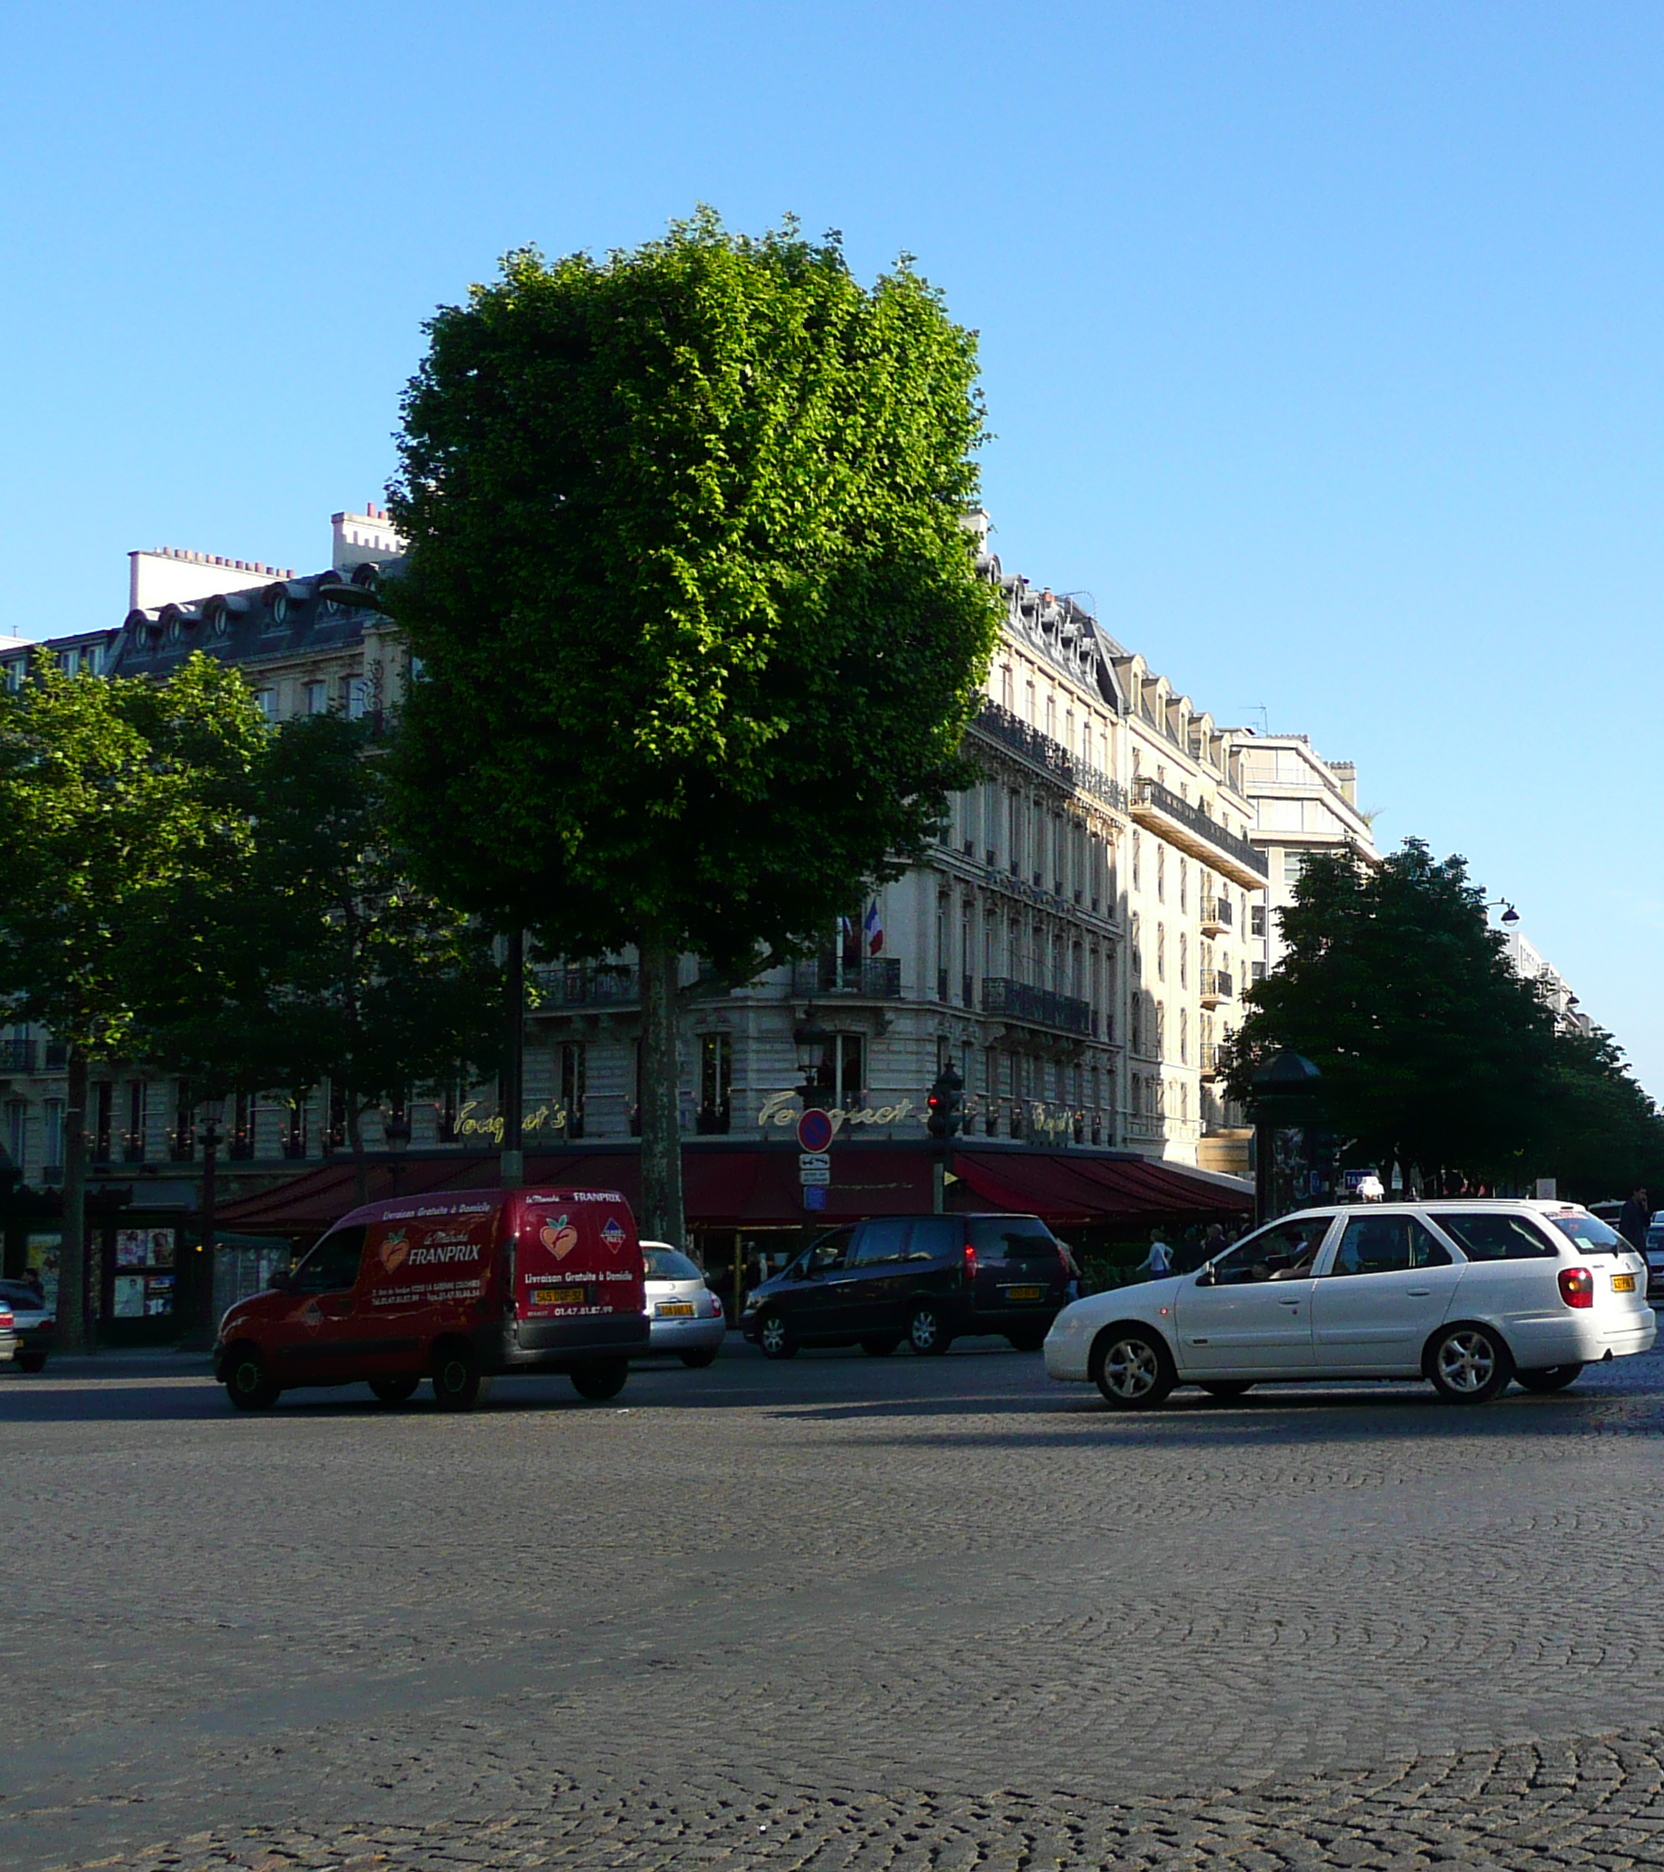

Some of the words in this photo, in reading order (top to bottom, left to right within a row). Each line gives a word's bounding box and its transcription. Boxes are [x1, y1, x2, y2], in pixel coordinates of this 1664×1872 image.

[453, 1101, 567, 1144] Fouqet's
[573, 1191, 622, 1203] FRANPRIX
[382, 1209, 416, 1221] Livraison
[417, 1206, 449, 1217] Gratuite
[458, 1201, 491, 1213] Domicile
[408, 1244, 482, 1266] FRANPRIX
[524, 1272, 563, 1284] Livraison
[564, 1271, 596, 1282] Gratuite
[606, 1270, 633, 1281] Domicile
